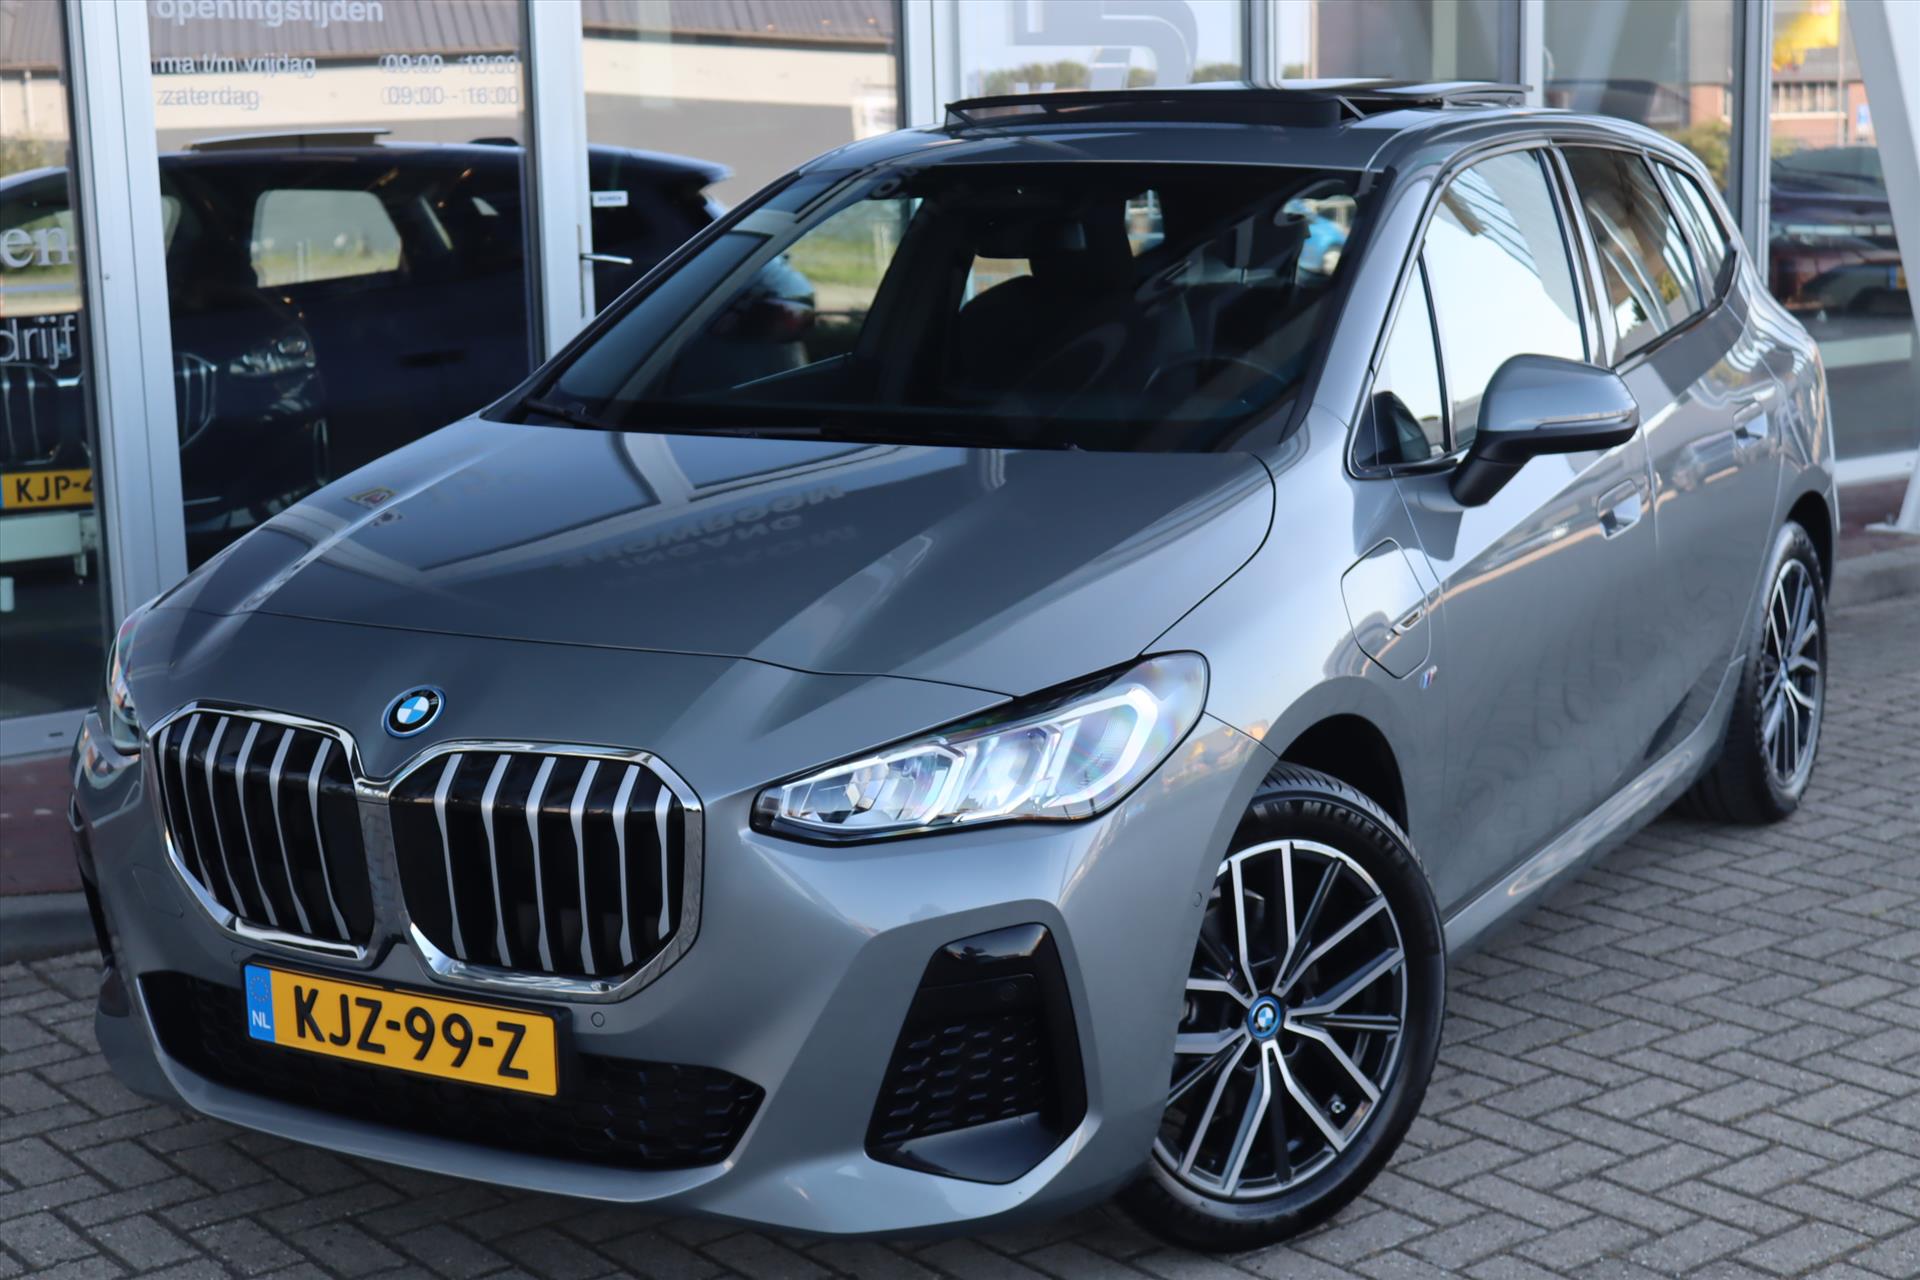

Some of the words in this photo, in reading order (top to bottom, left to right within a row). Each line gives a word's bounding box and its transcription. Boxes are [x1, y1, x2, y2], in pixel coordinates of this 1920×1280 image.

[157, 0, 384, 27] openingstijden
[159, 56, 199, 73] ma
[203, 53, 238, 73] t/m
[243, 53, 316, 78] vrijdag
[384, 54, 443, 74] 09:00
[159, 85, 260, 110] zaterdag
[386, 86, 445, 105] 09:00
[467, 86, 519, 105] 16:00
[1302, 800, 1407, 868] MICHELIN
[252, 1010, 271, 1030] NL
[294, 985, 529, 1080] KJZ-99-Z
